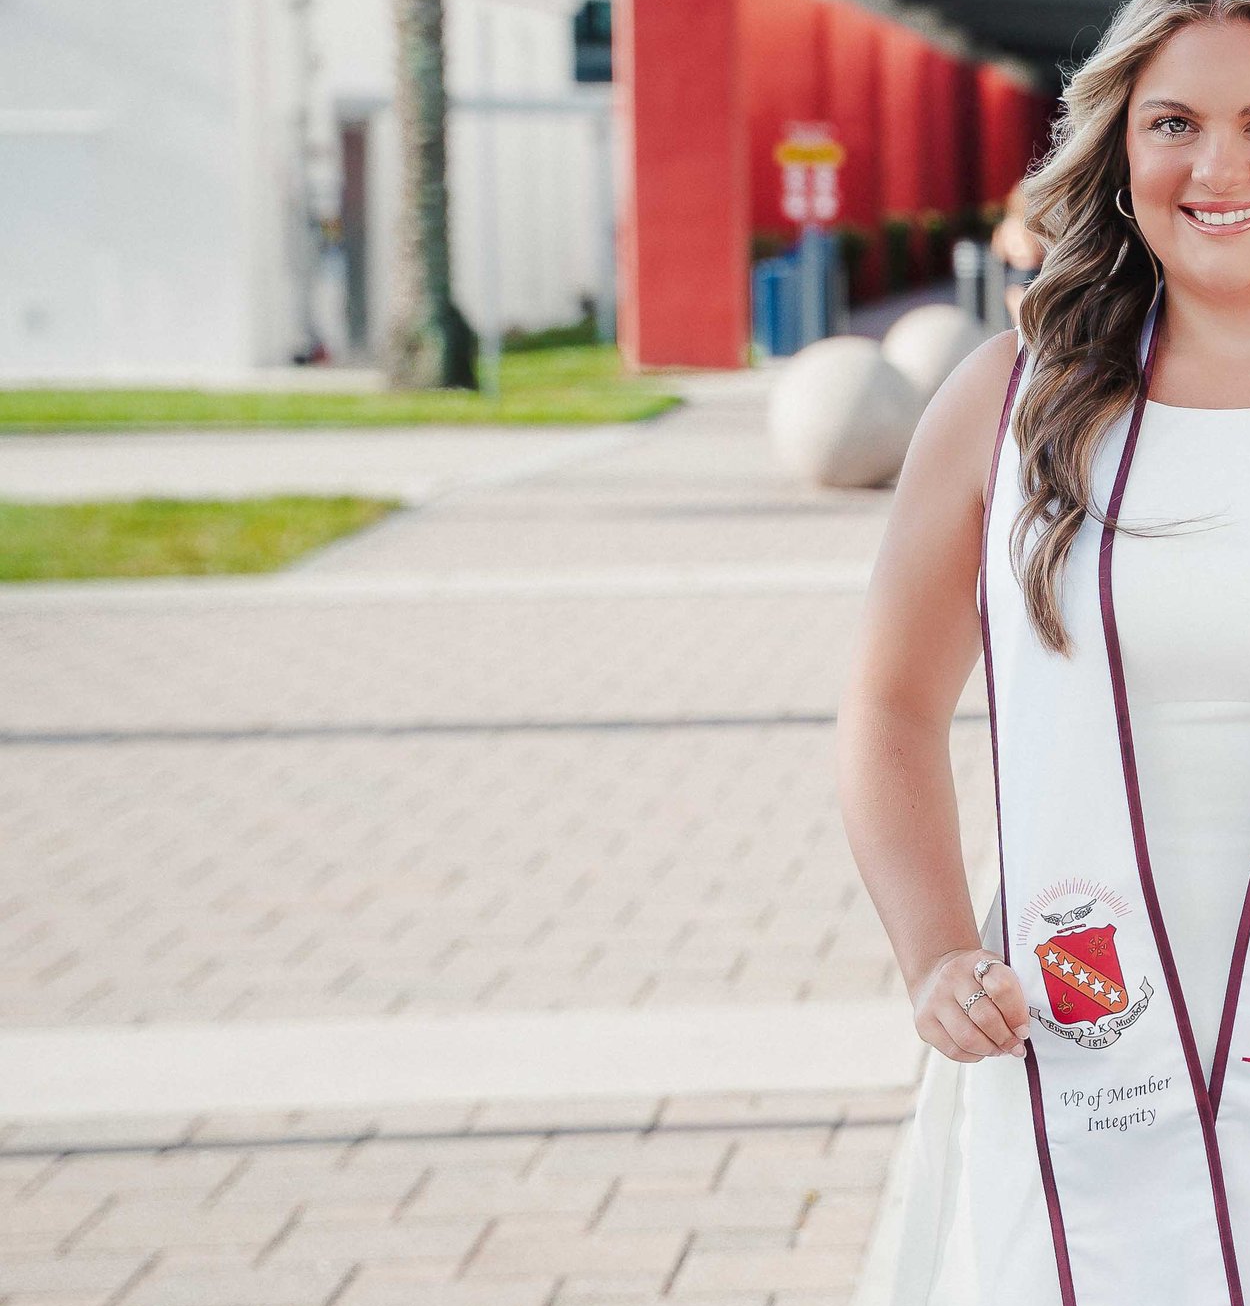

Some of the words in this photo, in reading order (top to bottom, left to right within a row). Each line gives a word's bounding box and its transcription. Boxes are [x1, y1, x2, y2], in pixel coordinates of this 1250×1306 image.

[1088, 1036, 1108, 1048] 1874
[1060, 1089, 1084, 1107] VP
[1087, 1088, 1104, 1111] of
[1107, 1075, 1172, 1104] Member
[1088, 1107, 1156, 1132] Integrity
